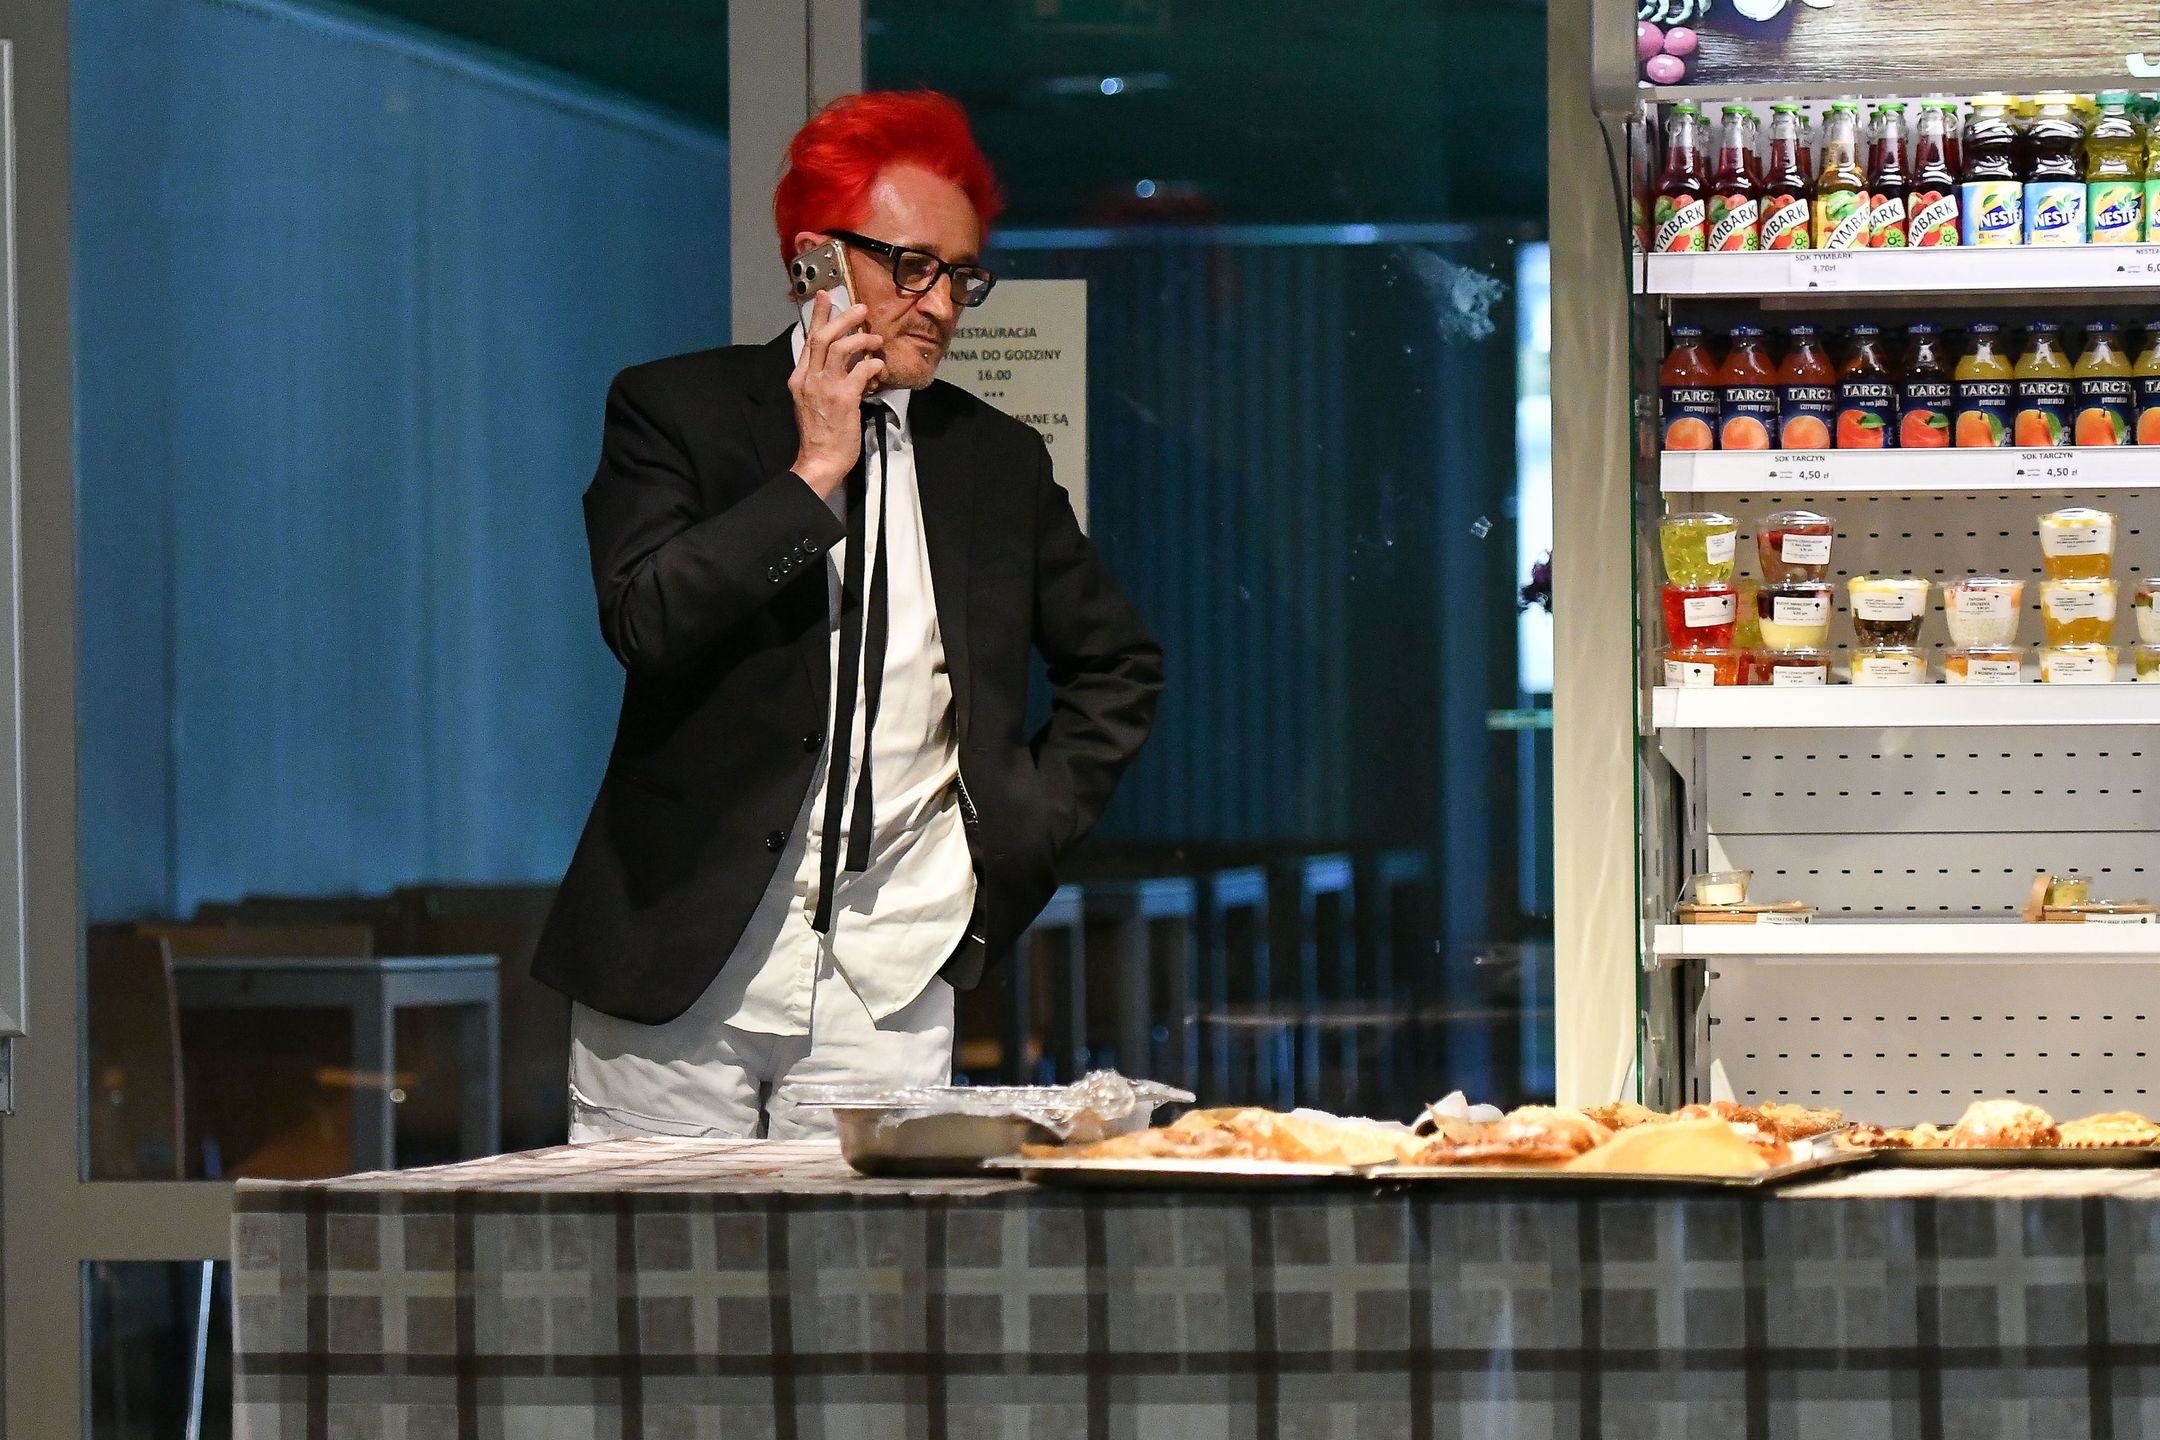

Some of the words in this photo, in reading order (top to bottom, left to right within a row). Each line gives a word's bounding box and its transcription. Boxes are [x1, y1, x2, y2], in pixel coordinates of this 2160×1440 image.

[2096, 208, 2142, 227] NESTEA
[1813, 252, 1853, 261] TYMBARK
[982, 349, 1001, 361] DO
[1004, 349, 1061, 361] GODZINY
[978, 369, 1012, 381] 16.00
[1799, 470, 1821, 480] 4,50
[2047, 467, 2069, 477] 4,50
